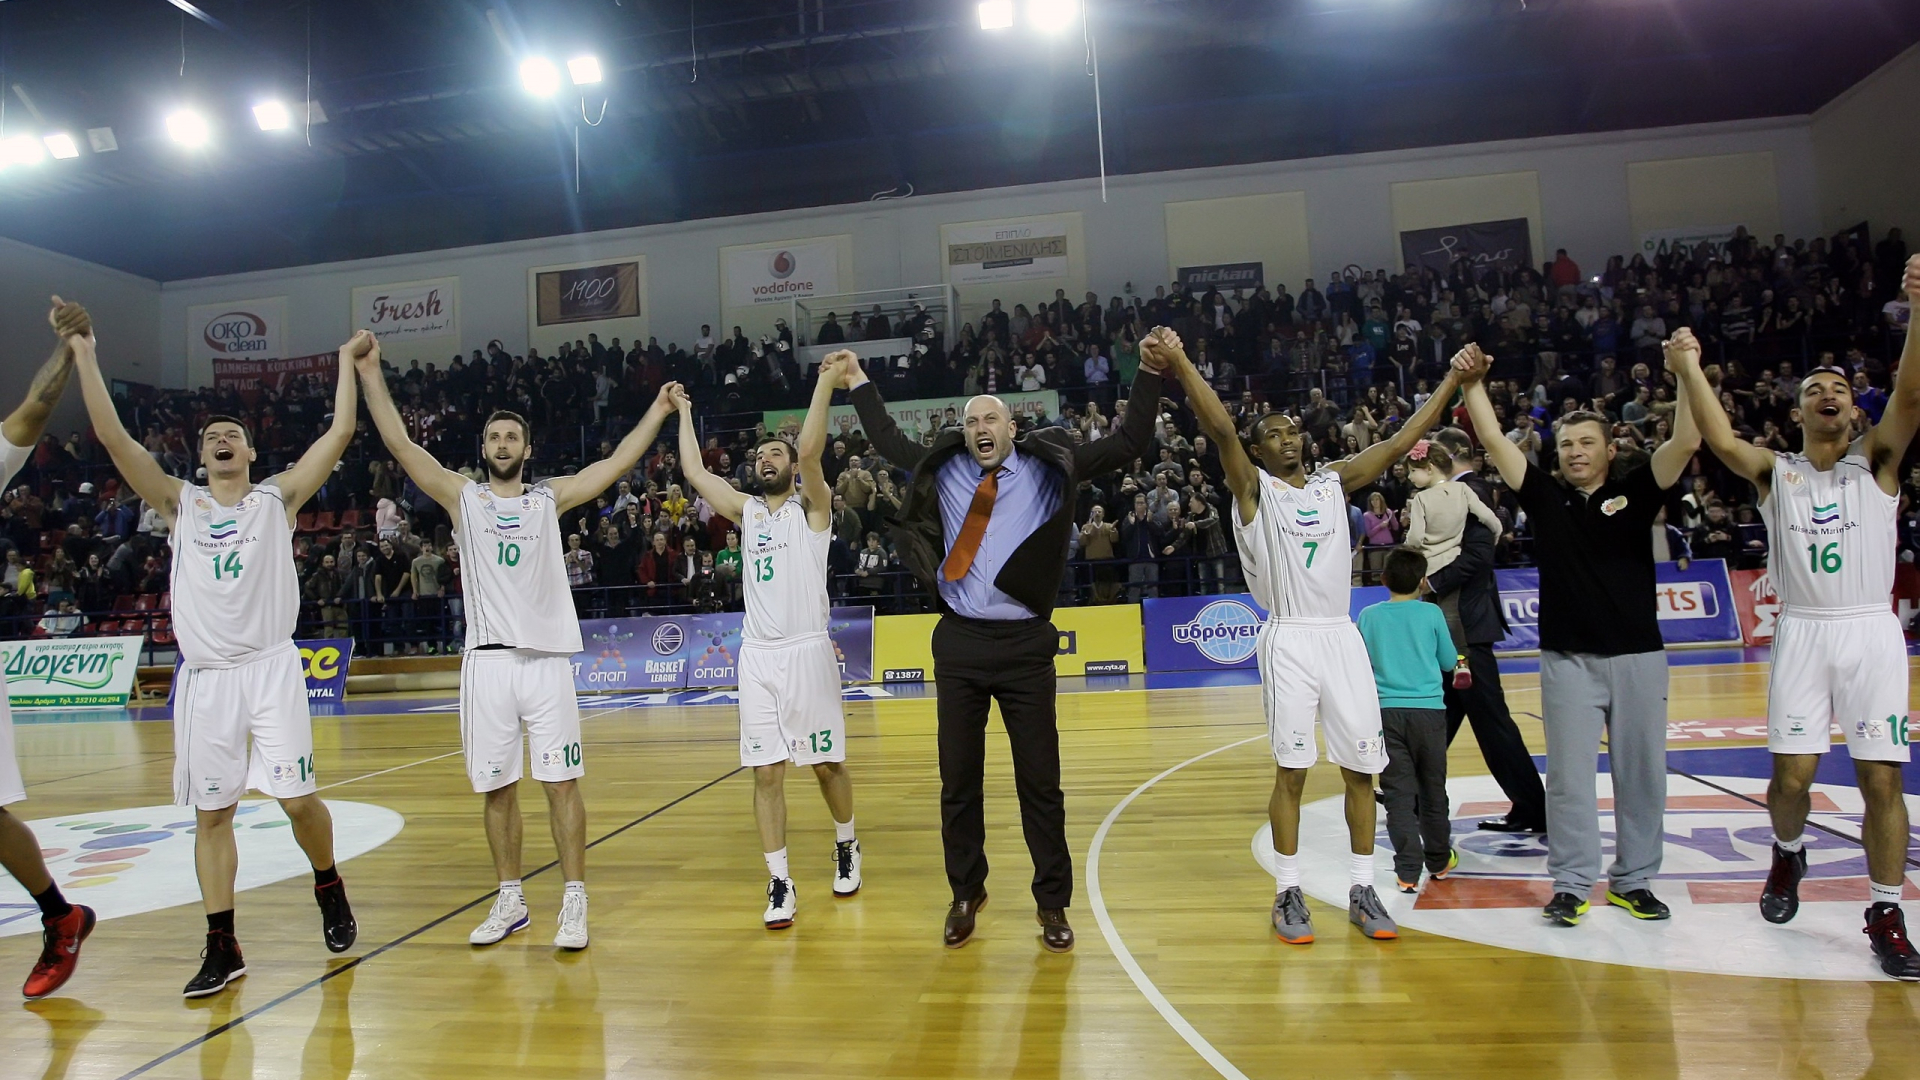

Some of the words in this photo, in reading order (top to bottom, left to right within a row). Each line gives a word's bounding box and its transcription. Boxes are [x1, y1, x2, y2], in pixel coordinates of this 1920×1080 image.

[1188, 268, 1256, 283] nickan
[563, 277, 615, 300] 1900
[752, 281, 813, 295] vodafone
[370, 289, 443, 323] Fresh
[211, 323, 252, 339] OKO
[228, 336, 267, 353] clean
[497, 541, 521, 567] 10
[1302, 541, 1318, 569] 7
[1808, 542, 1842, 574] 16
[212, 551, 243, 580] 14
[754, 555, 774, 583] 13
[1177, 622, 1264, 642] υδρόγει
[645, 659, 686, 674] BASKET
[895, 671, 922, 679] 13877
[1086, 663, 1127, 673] www.cyta.gr
[651, 672, 677, 683] LEAGUE
[75, 696, 97, 704] 25210
[809, 729, 833, 754] 13
[563, 742, 581, 768] 10
